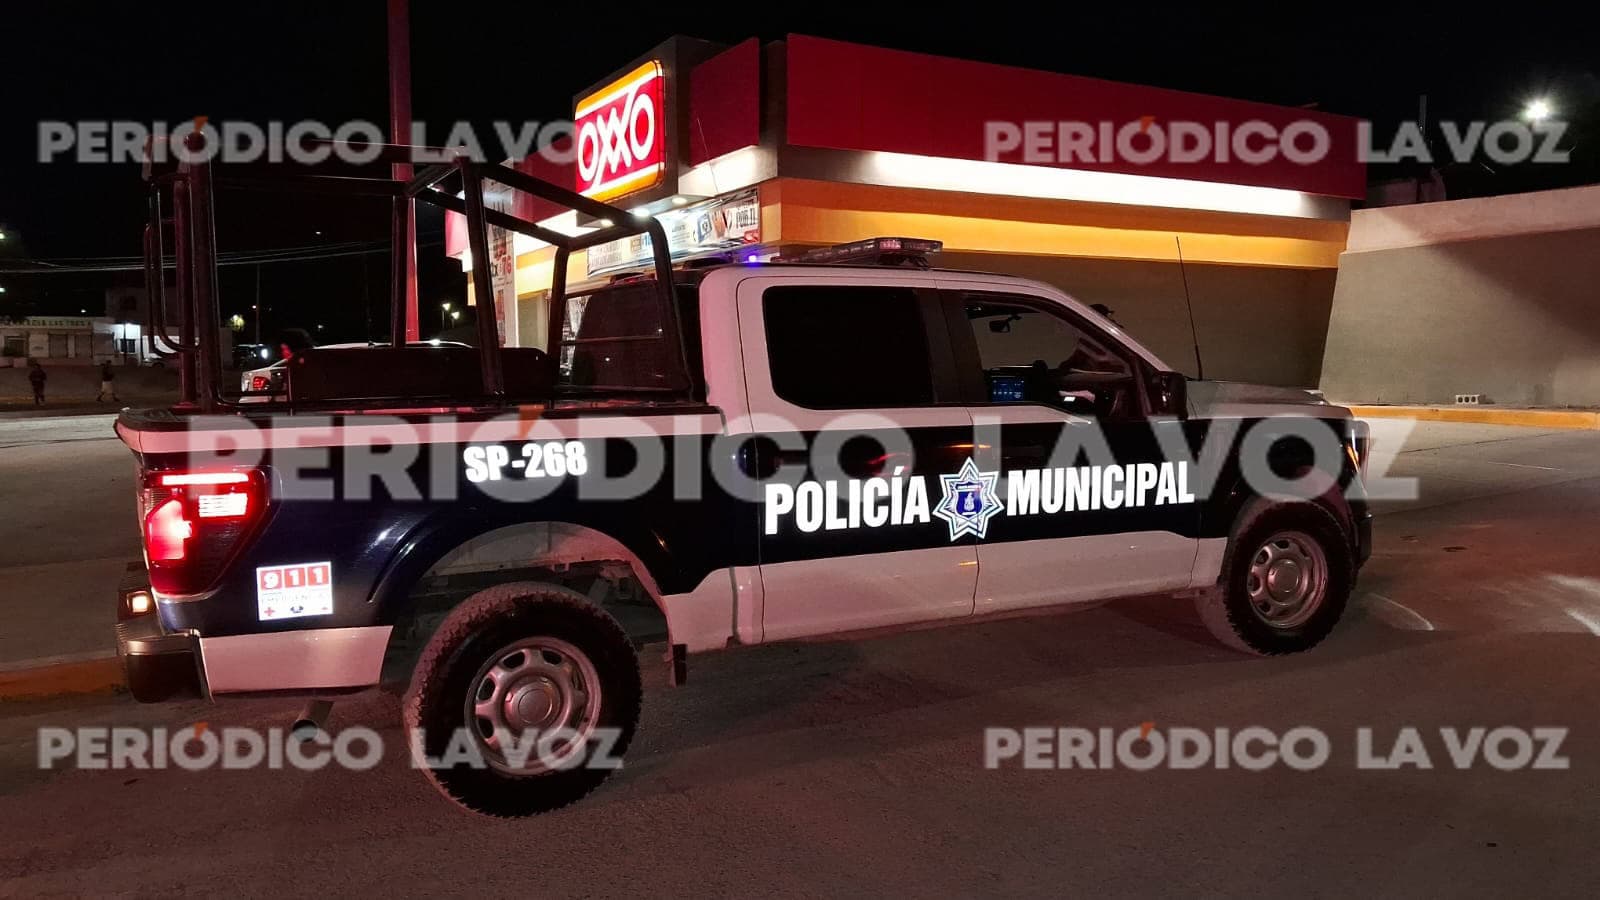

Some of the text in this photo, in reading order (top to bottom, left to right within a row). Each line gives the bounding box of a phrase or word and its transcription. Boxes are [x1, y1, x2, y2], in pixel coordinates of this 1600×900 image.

[577, 92, 655, 187] OXXO
[463, 441, 588, 483] SP-268
[765, 461, 1195, 536] POLICÍA MUNICIPAL
